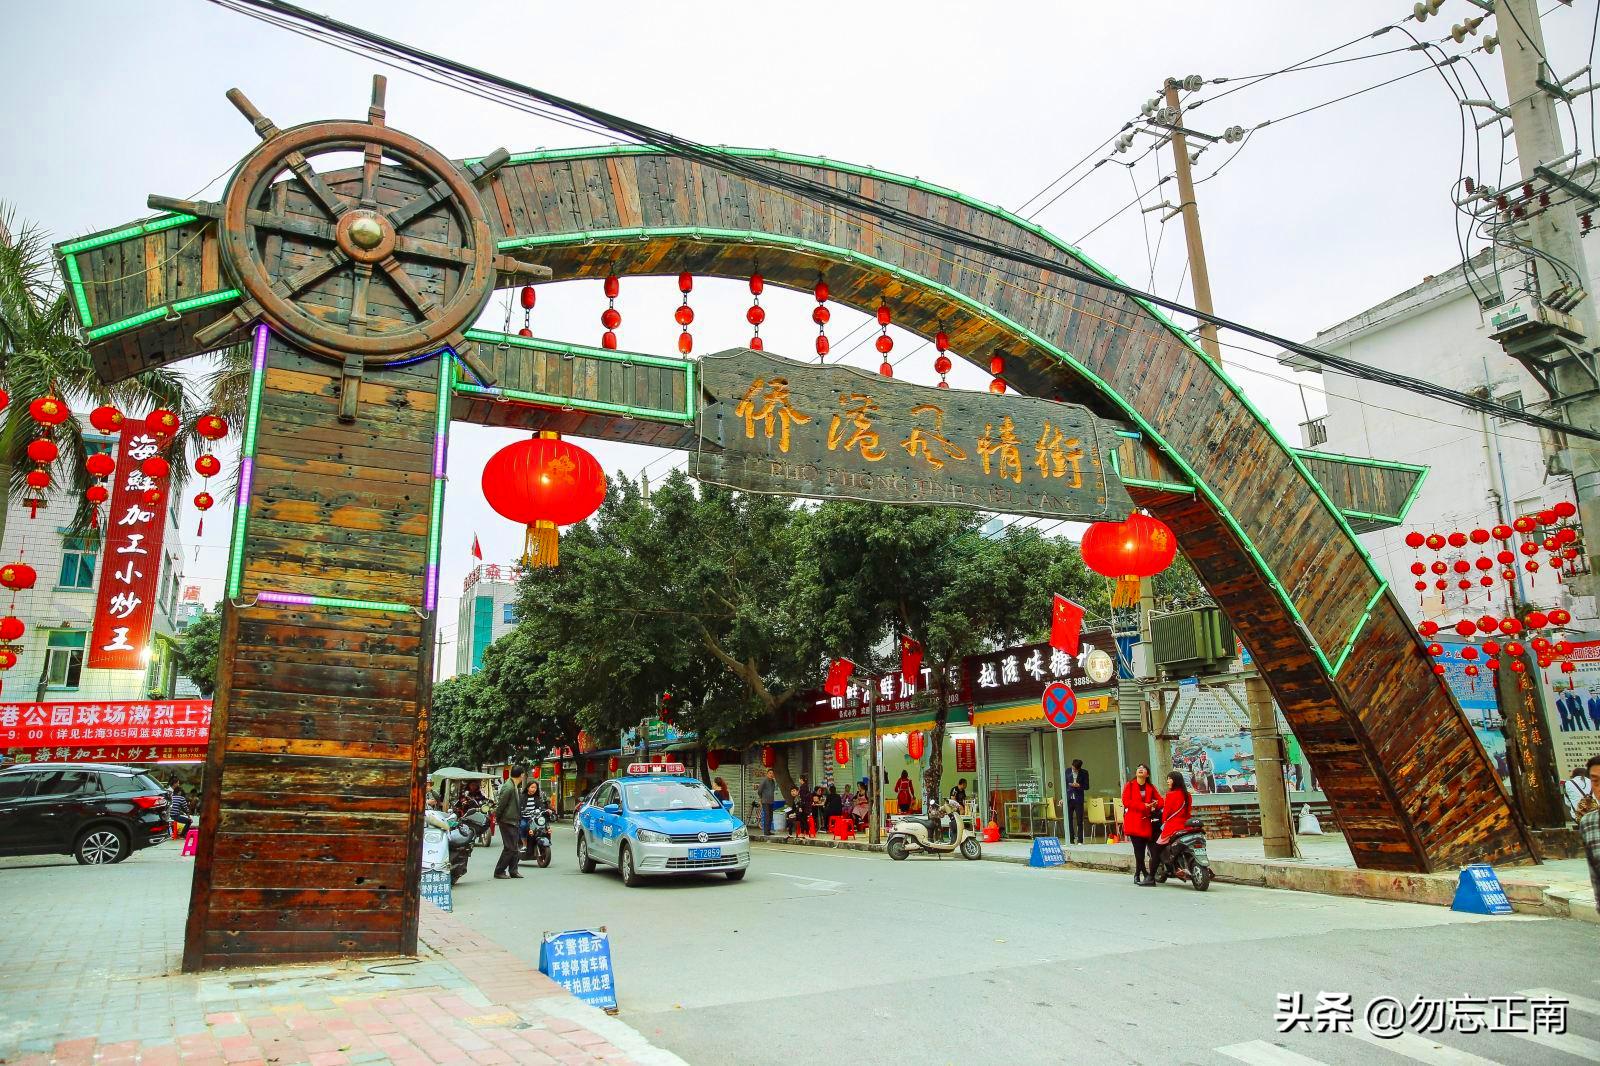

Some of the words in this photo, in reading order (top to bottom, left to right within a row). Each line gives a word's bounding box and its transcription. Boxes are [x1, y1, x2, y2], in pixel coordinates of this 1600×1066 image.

[553, 936, 602, 956] 交警提示
[552, 955, 608, 977] 严禁停放车辆
[557, 973, 611, 994] 者拍照处理
